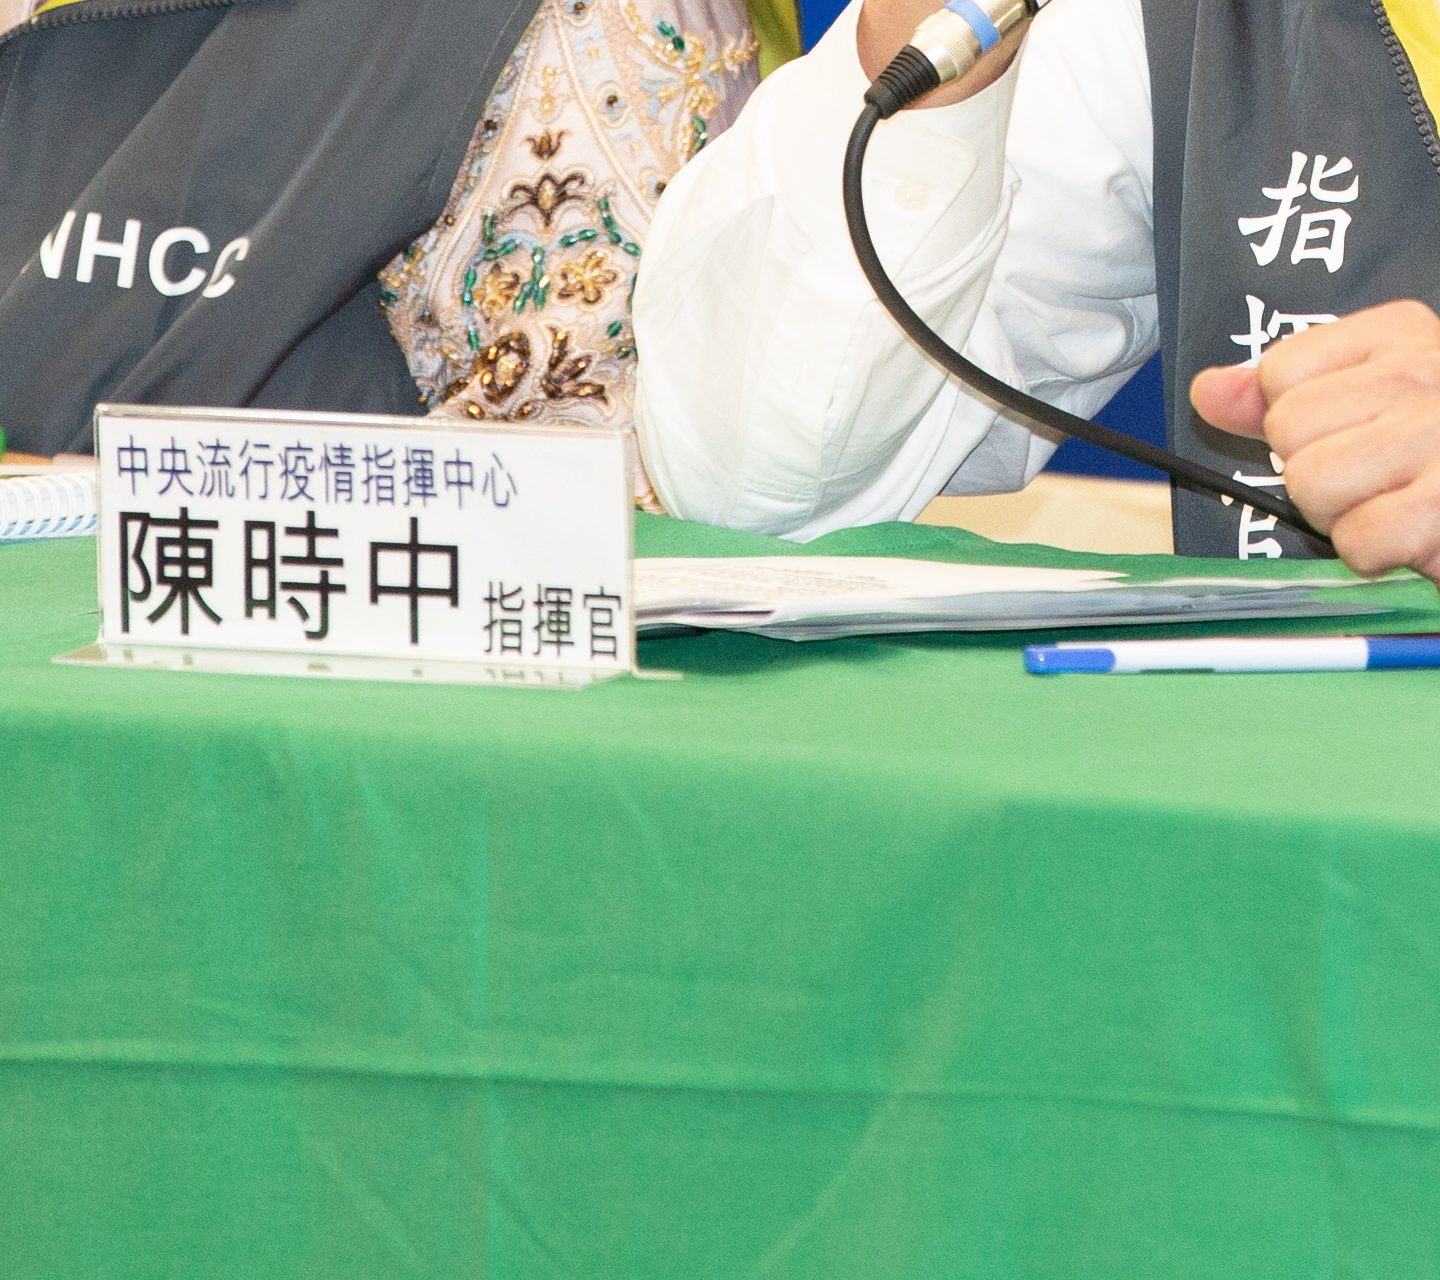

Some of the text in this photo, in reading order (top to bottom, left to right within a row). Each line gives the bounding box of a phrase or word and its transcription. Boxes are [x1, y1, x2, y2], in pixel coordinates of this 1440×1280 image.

[116, 434, 519, 511] 中央流行疫情指揮中心
[118, 507, 622, 662] 陳時中 指揮官
